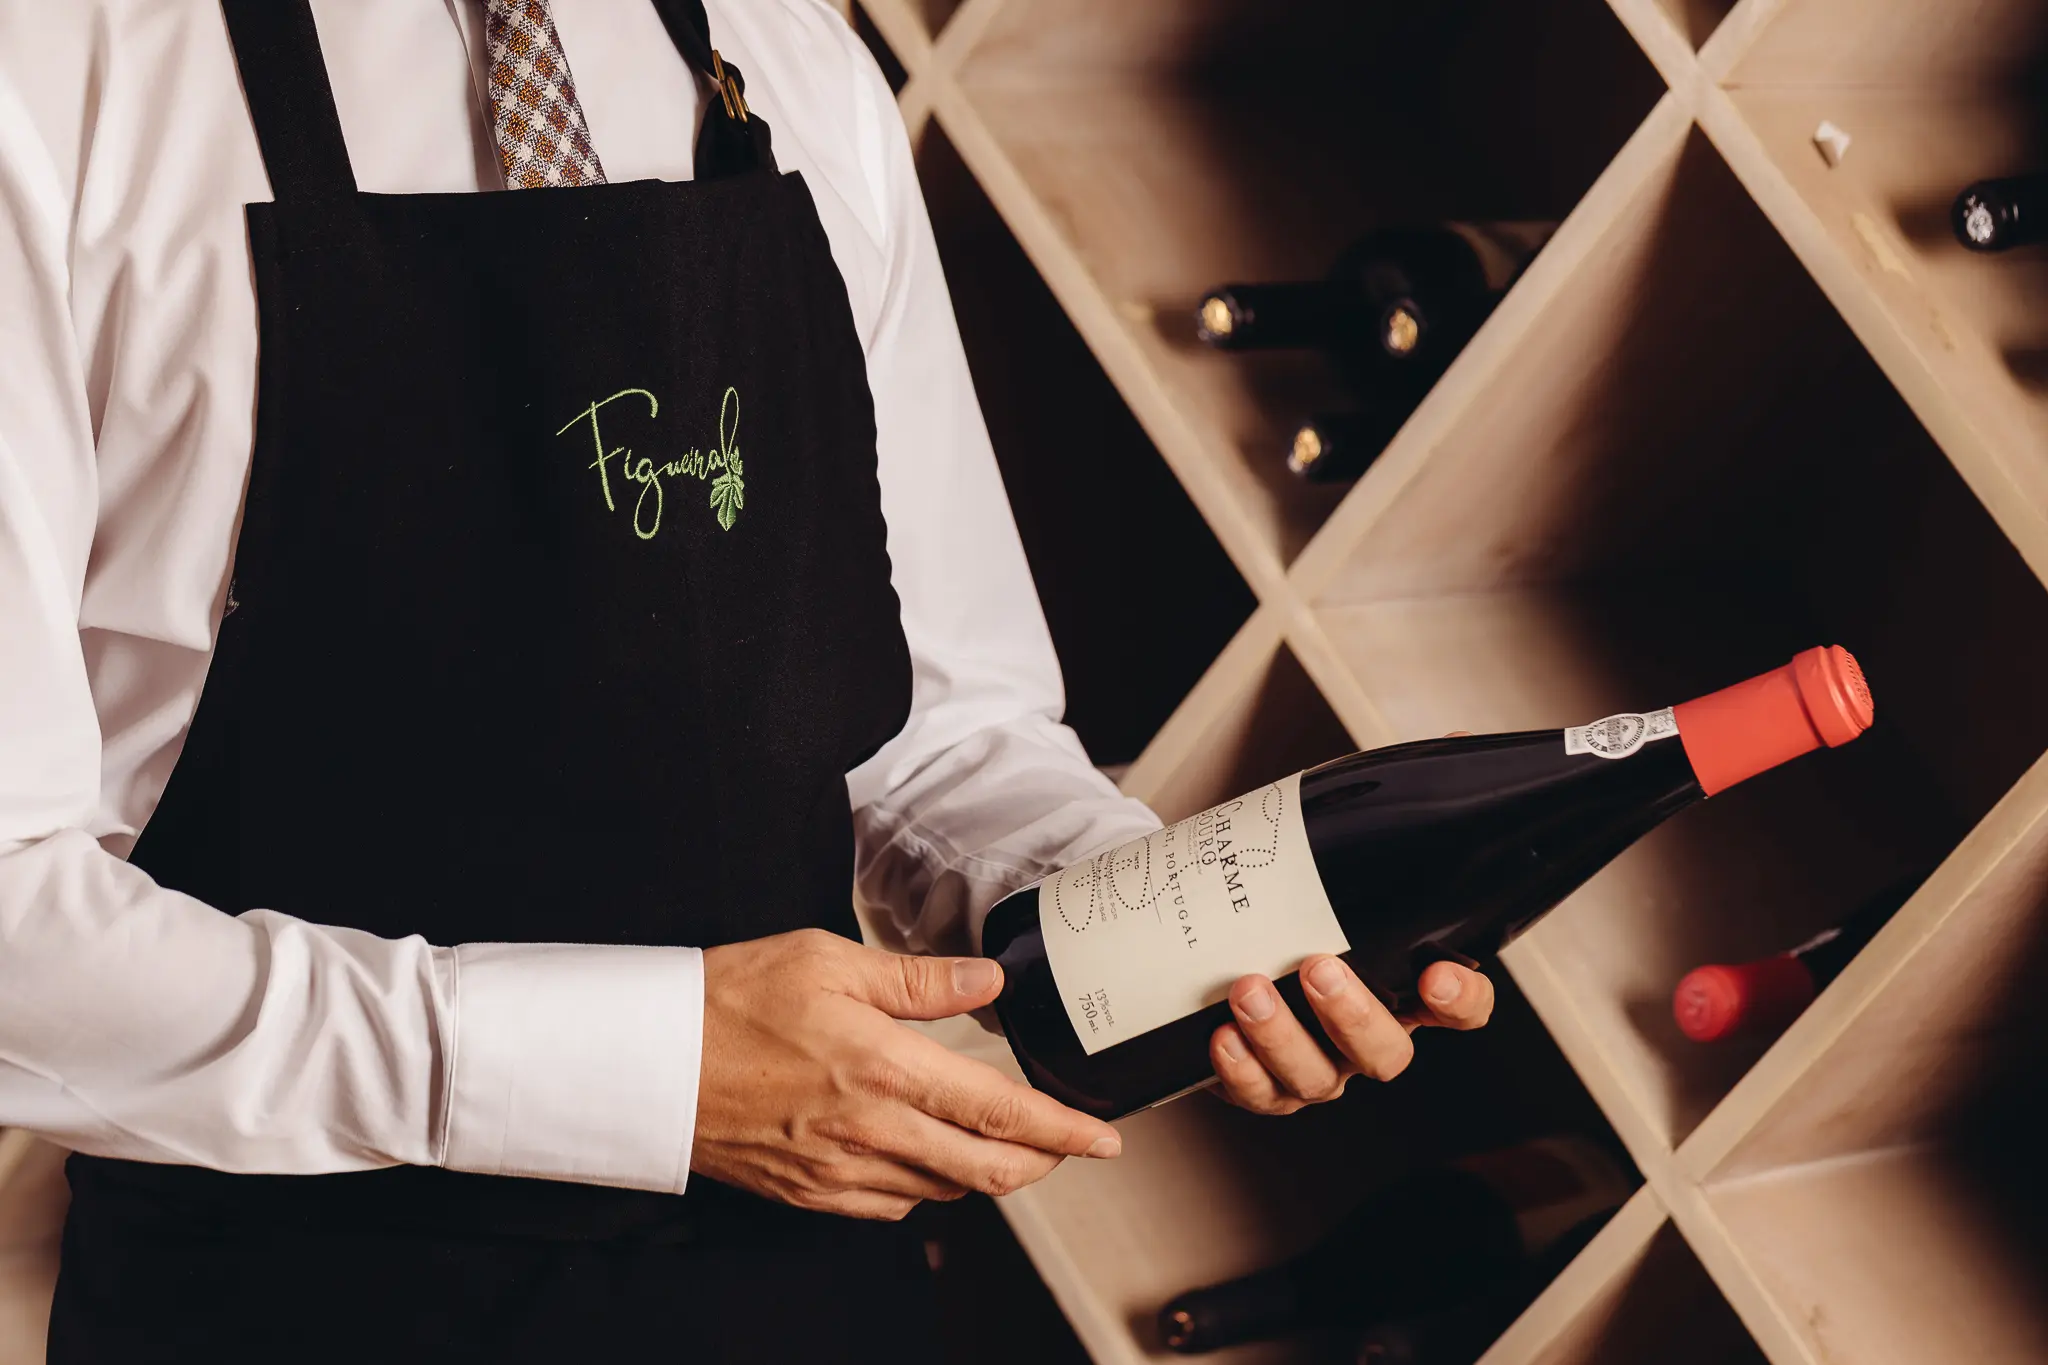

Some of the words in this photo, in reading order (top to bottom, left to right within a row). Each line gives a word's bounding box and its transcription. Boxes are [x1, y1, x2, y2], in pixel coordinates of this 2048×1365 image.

[1162, 825, 1176, 847] ORT,
[1216, 801, 1250, 913] CHARME
[1165, 852, 1198, 949] PORTUGAL
